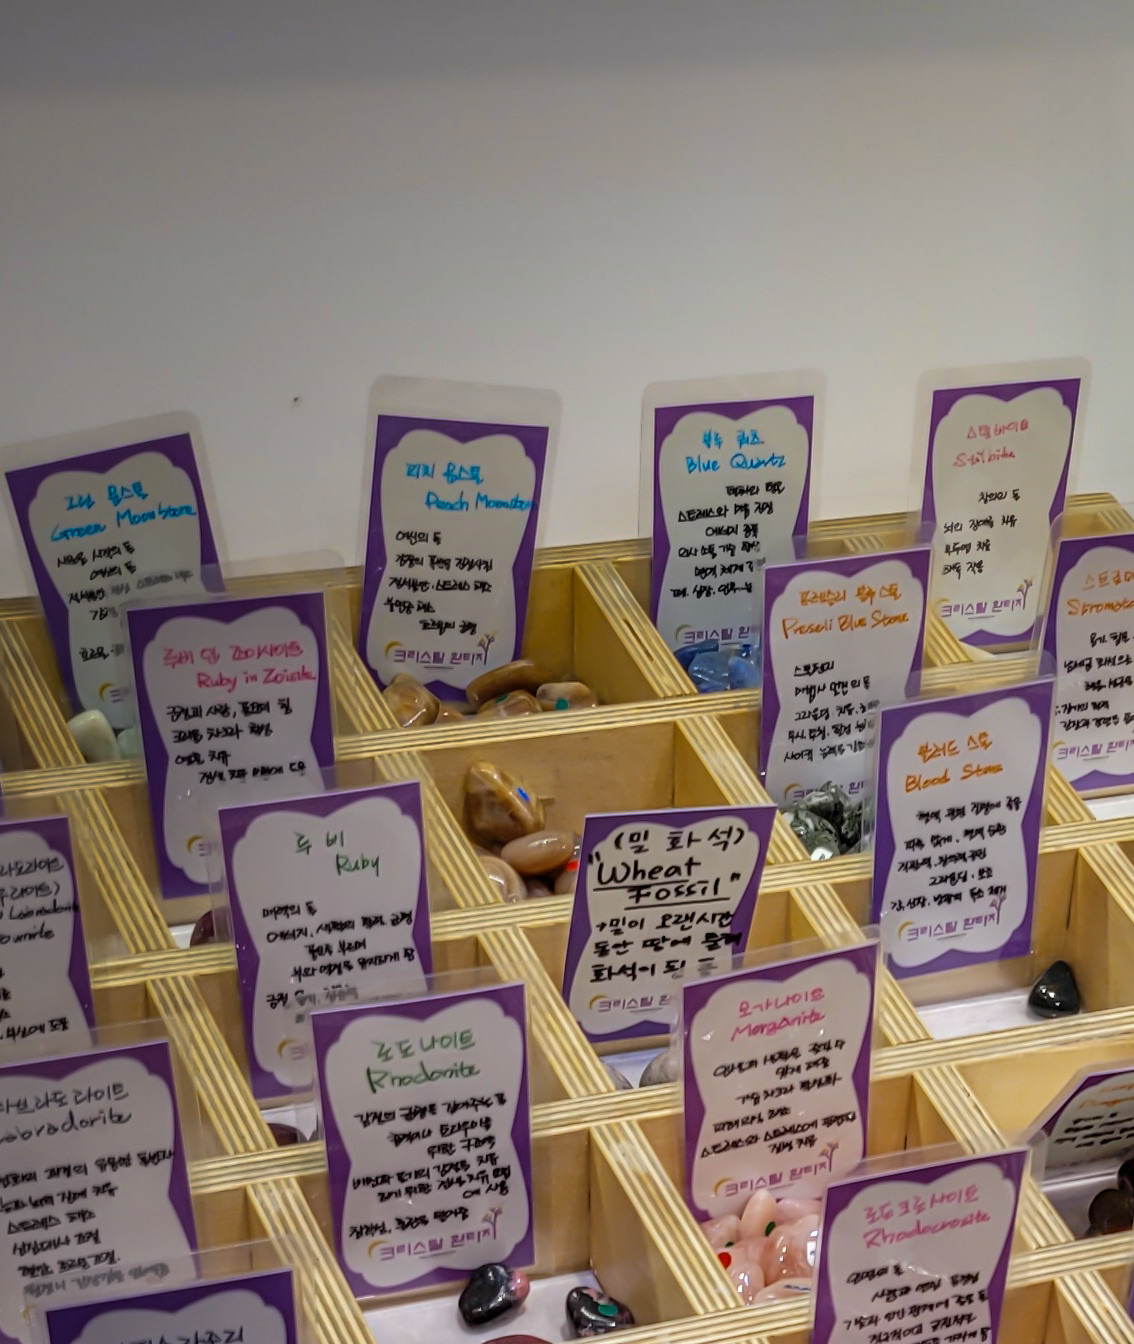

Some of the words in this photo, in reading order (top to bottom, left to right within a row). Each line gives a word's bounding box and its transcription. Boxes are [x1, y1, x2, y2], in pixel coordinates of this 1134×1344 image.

[686, 455, 720, 474] Blue
[197, 672, 237, 693] Ruby
[906, 773, 949, 793] Blood
[336, 853, 381, 877] Ruby
